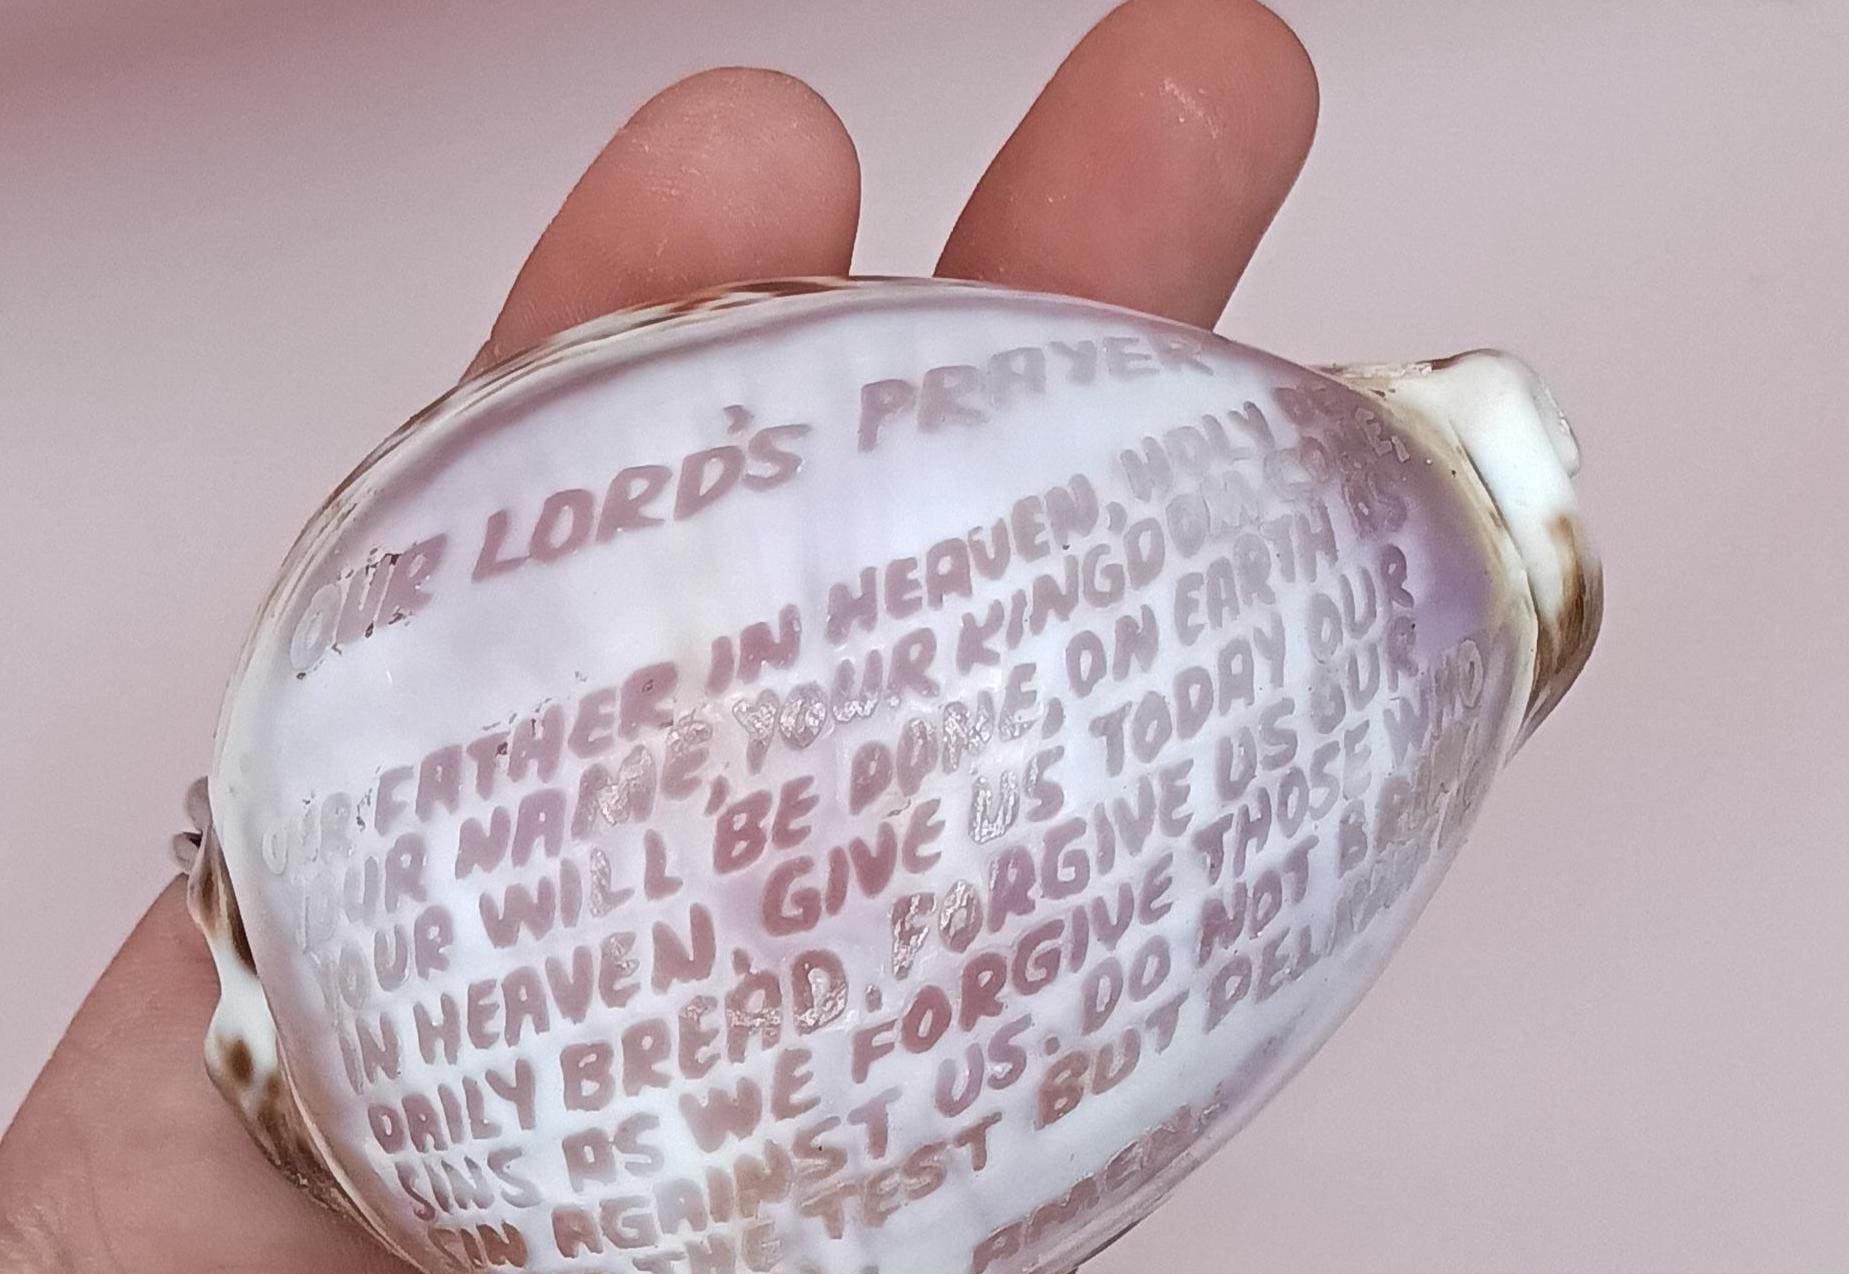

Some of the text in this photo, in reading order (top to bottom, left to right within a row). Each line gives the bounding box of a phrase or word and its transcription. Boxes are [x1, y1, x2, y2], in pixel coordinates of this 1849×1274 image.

[290, 333, 1214, 674] OUR LORD'S PRAYER
[374, 661, 680, 836] FATHER
[706, 604, 801, 695] IN
[824, 473, 1127, 646] HEAVEN,
[1120, 401, 1275, 501] HOLY
[455, 718, 729, 880] NAME,
[732, 627, 940, 774] YOUR
[956, 470, 1264, 675] KINGDOM
[340, 1008, 400, 1094] IN
[761, 799, 946, 937] GIVE
[969, 746, 1065, 843] US
[1089, 612, 1286, 777] TODAY
[1308, 544, 1415, 663] OUR
[368, 616, 1419, 1154] DAILY BREAD. FORGIVE US OUR
[479, 829, 683, 948] WILL
[713, 775, 820, 874] BE
[851, 662, 1064, 815] DONE,
[1065, 604, 1159, 698] ON
[1174, 500, 1339, 646] EARTH
[396, 1147, 541, 1221] SINS
[562, 1112, 665, 1192] AS
[678, 1048, 821, 1153] WE
[852, 852, 1174, 1083] FORGIVE
[1191, 719, 1372, 885] THOSE
[427, 1221, 528, 1274] SIN
[552, 1088, 900, 1259] AGAINST
[936, 1013, 1060, 1117] US.
[1081, 935, 1171, 1035] DO
[1199, 835, 1319, 968] NOT
[799, 1112, 1002, 1240] TEST
[1035, 989, 1190, 1130] BUT
